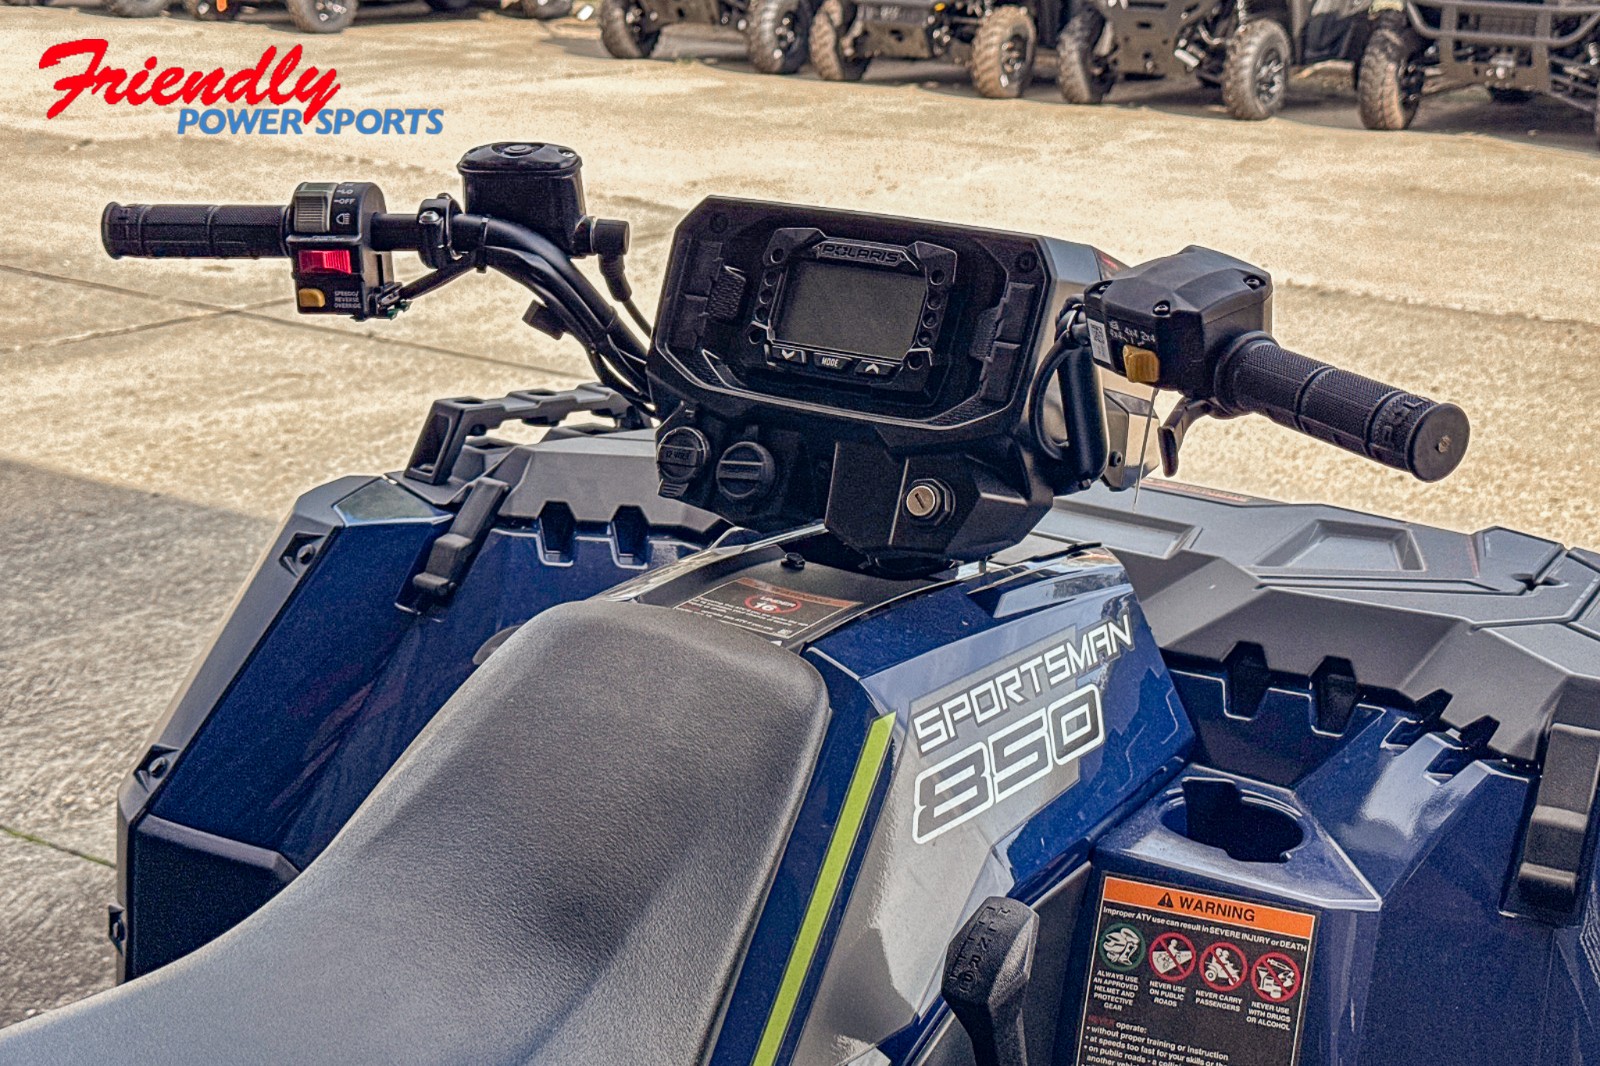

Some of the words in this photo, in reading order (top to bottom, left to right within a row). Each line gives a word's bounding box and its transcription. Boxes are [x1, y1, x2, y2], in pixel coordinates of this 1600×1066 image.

[822, 244, 899, 263] POLARIS
[821, 356, 839, 368] MODE
[754, 602, 778, 611] 16
[914, 614, 1133, 753] SPORTSMAN
[912, 684, 1105, 844] 850
[1180, 895, 1255, 922] WARNING
[1103, 906, 1135, 919] Improper
[1136, 912, 1152, 922] ATV
[1152, 916, 1165, 925] use
[1166, 919, 1180, 928] can
[1180, 921, 1202, 931] result
[1202, 925, 1209, 933] in
[1210, 926, 1241, 939] SEVERE
[1242, 935, 1271, 946] INJURY
[1280, 940, 1307, 952] DEATH
[1093, 976, 1103, 984] AN
[1103, 979, 1139, 991] APPROVED
[1097, 970, 1124, 980] ALWAYS
[1125, 975, 1139, 983] USE
[1094, 985, 1120, 995] HELMET
[1121, 990, 1135, 998] AND
[1149, 980, 1172, 990] NEVER
[1172, 985, 1187, 993] USE
[1093, 992, 1133, 1006] PROTECTIVE
[1149, 988, 1159, 996] ON
[1160, 991, 1185, 1000] PUBLIC
[1195, 990, 1218, 1000] NEVER
[1219, 994, 1243, 1004] CARRY
[1103, 1002, 1123, 1011] GEAR
[1153, 997, 1178, 1007] ROADS
[1195, 997, 1241, 1012] PASSENGERS
[1251, 1001, 1275, 1011] NEVER
[1275, 1006, 1290, 1014] USE
[1248, 1008, 1266, 1017] WITH
[1266, 1012, 1291, 1023] DRUGS
[1115, 1022, 1148, 1034] operate:
[1257, 1019, 1290, 1031] ALCOHOL
[1091, 1026, 1119, 1038] without
[1120, 1032, 1145, 1044] proper
[1147, 1037, 1176, 1051] training
[1177, 1044, 1186, 1052] or
[1187, 1045, 1229, 1061] instruction
[1088, 1045, 1098, 1053] on
[1100, 1048, 1123, 1058] public
[1124, 1053, 1146, 1063] roads
[1099, 1038, 1126, 1050] speeds
[1126, 1043, 1140, 1052] too
[1140, 1046, 1155, 1055] fast
[1156, 1049, 1167, 1057] for
[1168, 1053, 1186, 1061] your
[1186, 1056, 1205, 1066] skills
[1087, 1055, 1116, 1066] another
